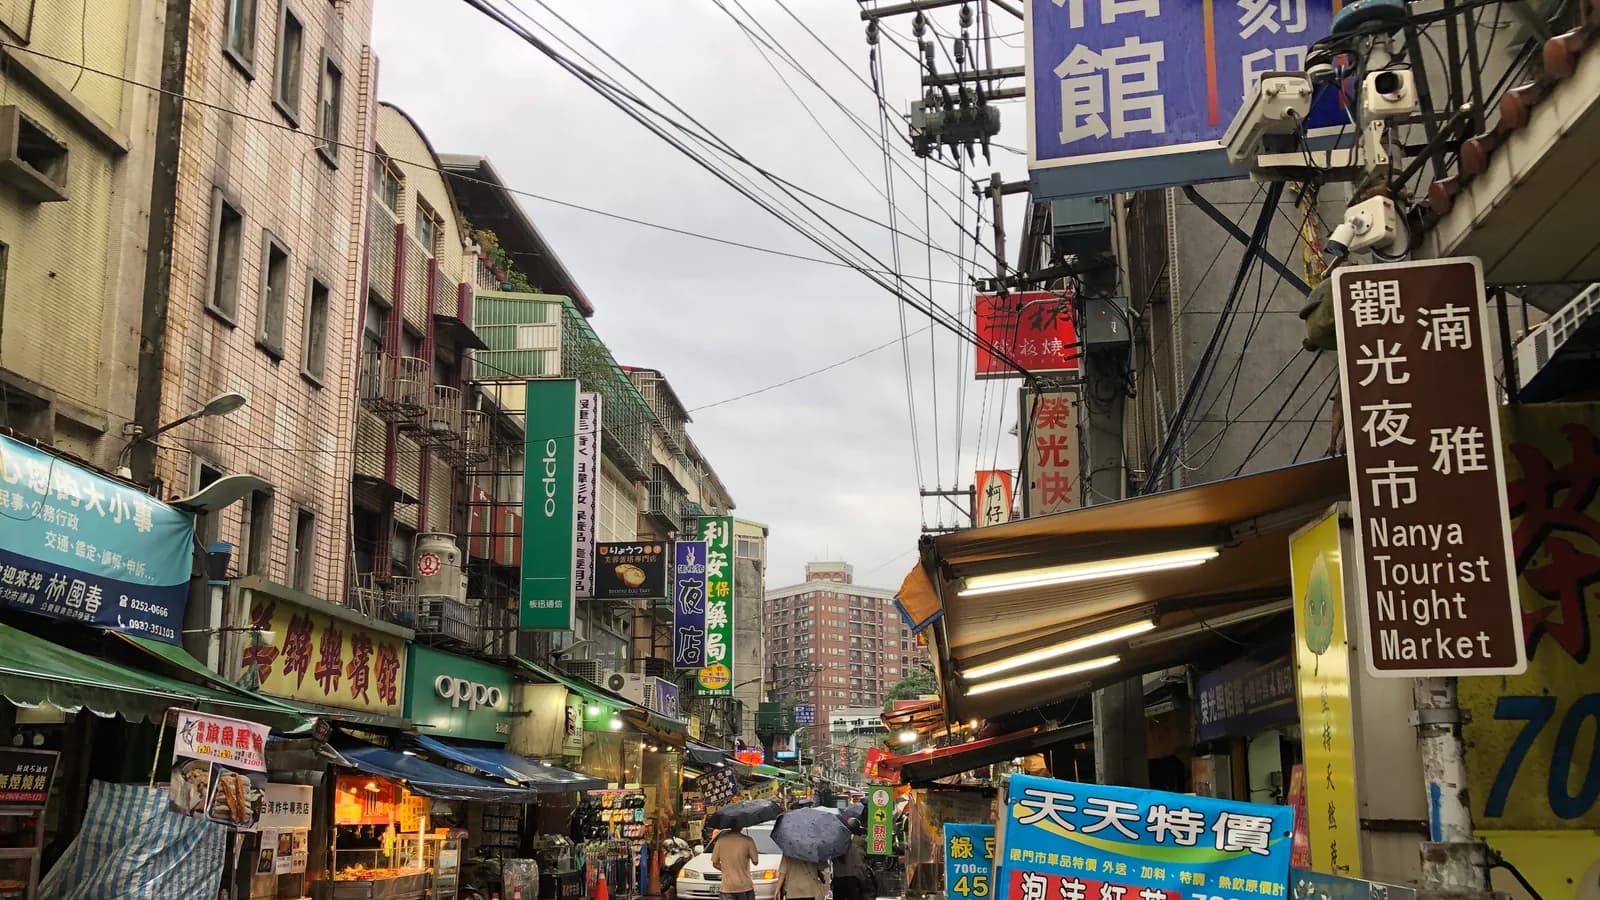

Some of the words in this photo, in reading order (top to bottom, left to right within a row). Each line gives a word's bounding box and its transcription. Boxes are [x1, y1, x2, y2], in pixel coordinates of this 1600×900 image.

[1349, 280, 1418, 508] 觀光夜市
[1417, 303, 1488, 474] 湳雅
[1036, 397, 1072, 516] 榮光快
[1370, 517, 1463, 550] Nanya
[0, 564, 43, 591] 迎來找
[1373, 553, 1490, 585] Tourist
[45, 573, 102, 613] 林國春
[131, 598, 168, 617] 8252-0666
[1377, 589, 1467, 625] Night
[677, 578, 703, 664] 夜店
[1380, 628, 1492, 660] Market
[205, 721, 263, 752] 旗魚黑輪
[873, 824, 887, 852] 熱飲
[1018, 788, 1273, 856] 天天特價
[954, 864, 988, 874] 700cc
[1010, 848, 1097, 873] 限門市單品特價
[953, 876, 988, 897] 45
